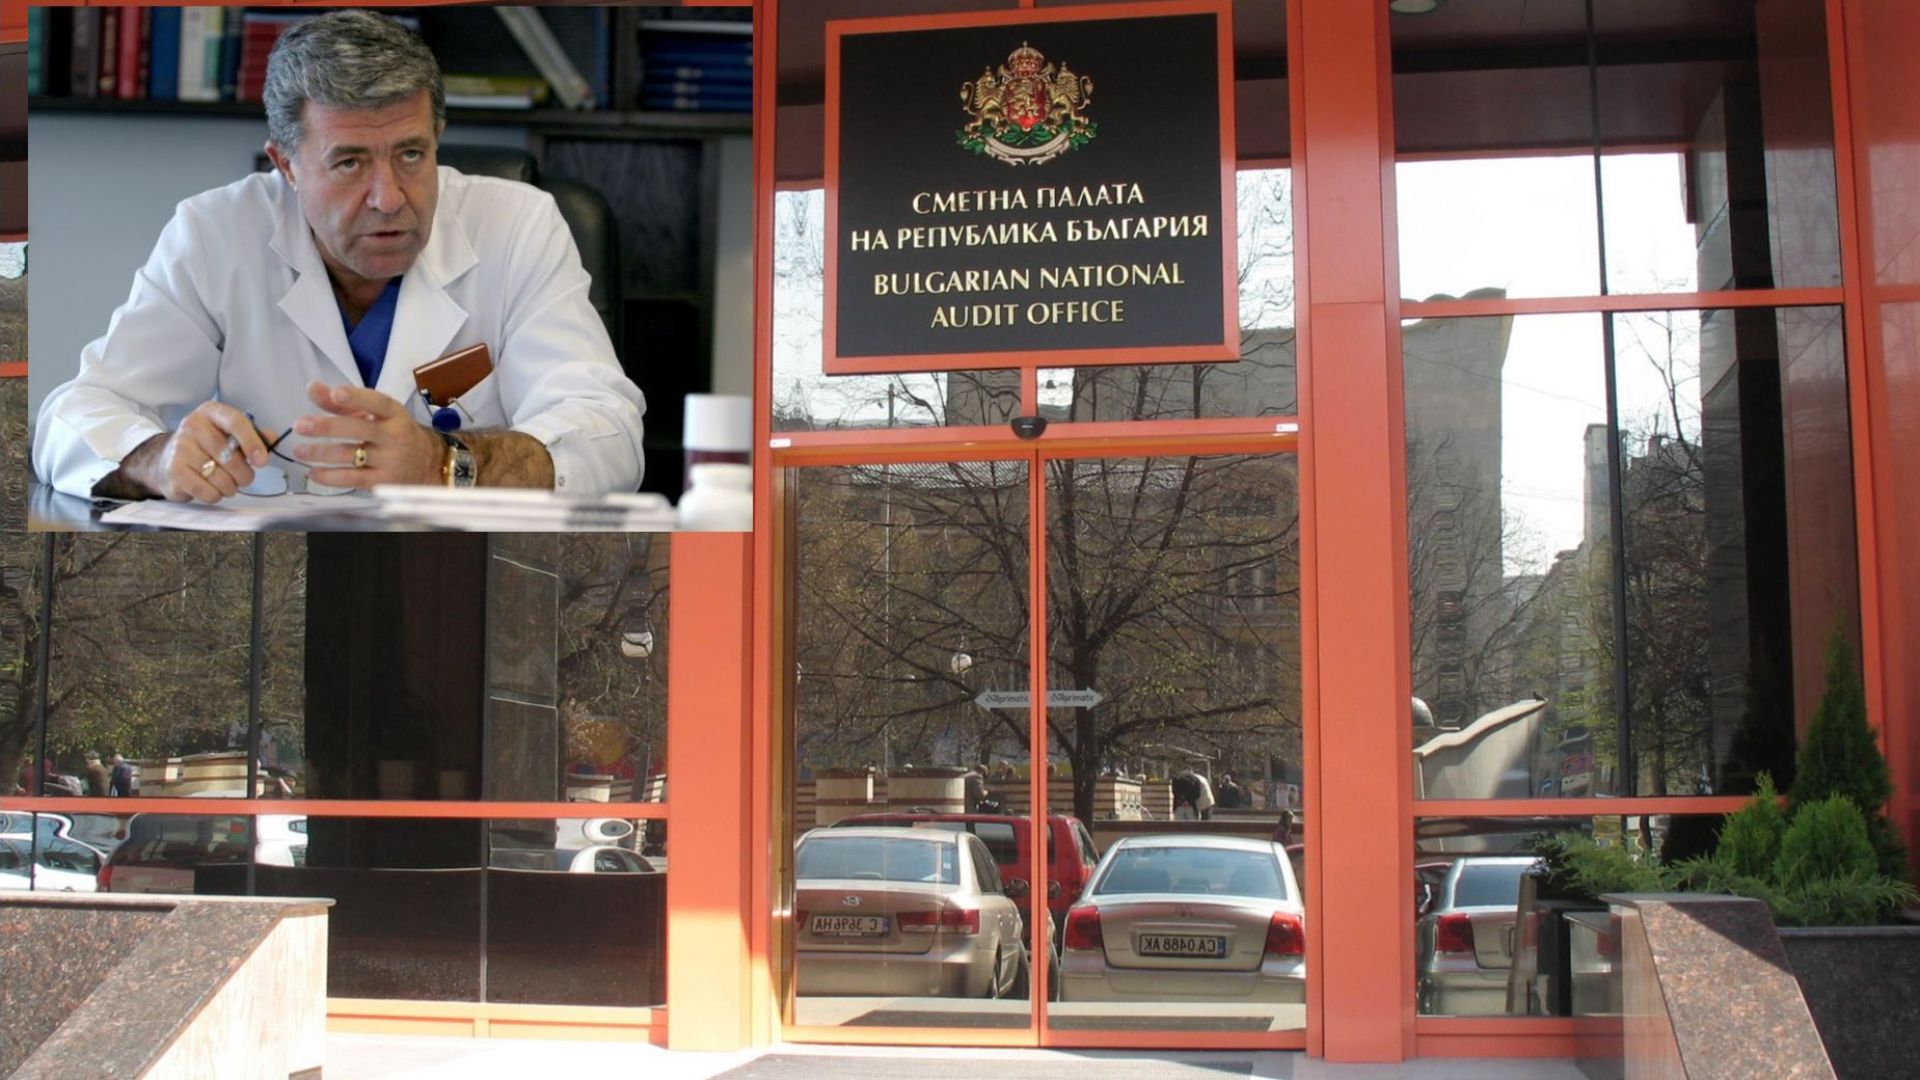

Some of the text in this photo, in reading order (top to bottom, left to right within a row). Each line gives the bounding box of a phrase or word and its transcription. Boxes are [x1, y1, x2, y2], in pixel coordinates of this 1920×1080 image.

[912, 182, 1145, 214] СМЕТНА ПАЛАТА
[851, 214, 1208, 251] НА РЕПУБЛИКА БЪЛГАРИЯ
[874, 262, 1185, 295] BULGARIAN NATIONAL
[930, 300, 1124, 328] AUDIT OFFICE
